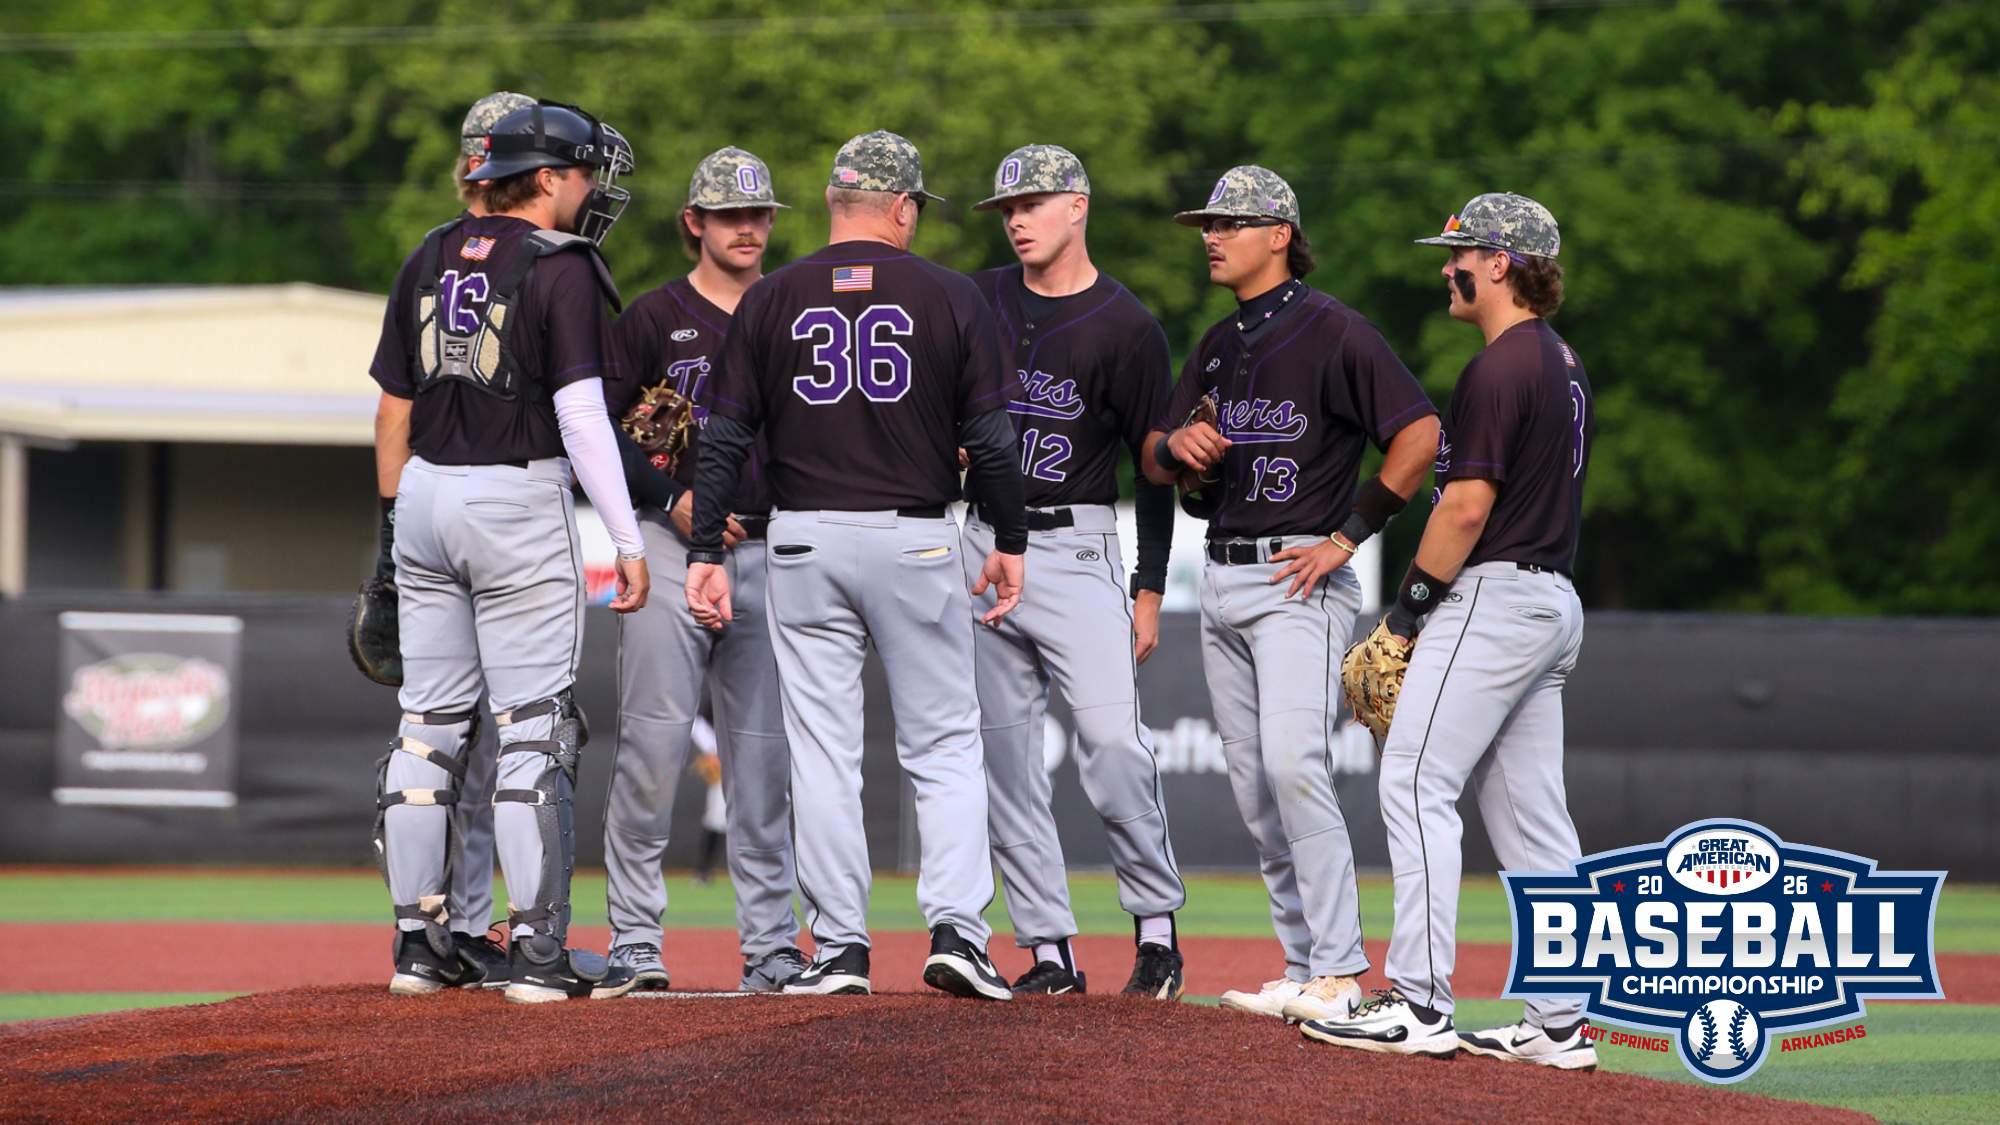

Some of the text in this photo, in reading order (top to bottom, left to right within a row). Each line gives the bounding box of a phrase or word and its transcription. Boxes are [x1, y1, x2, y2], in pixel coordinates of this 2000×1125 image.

[735, 165, 759, 194] O
[791, 305, 914, 405] 36
[1022, 428, 1073, 482] 12
[1246, 456, 1300, 501] 13
